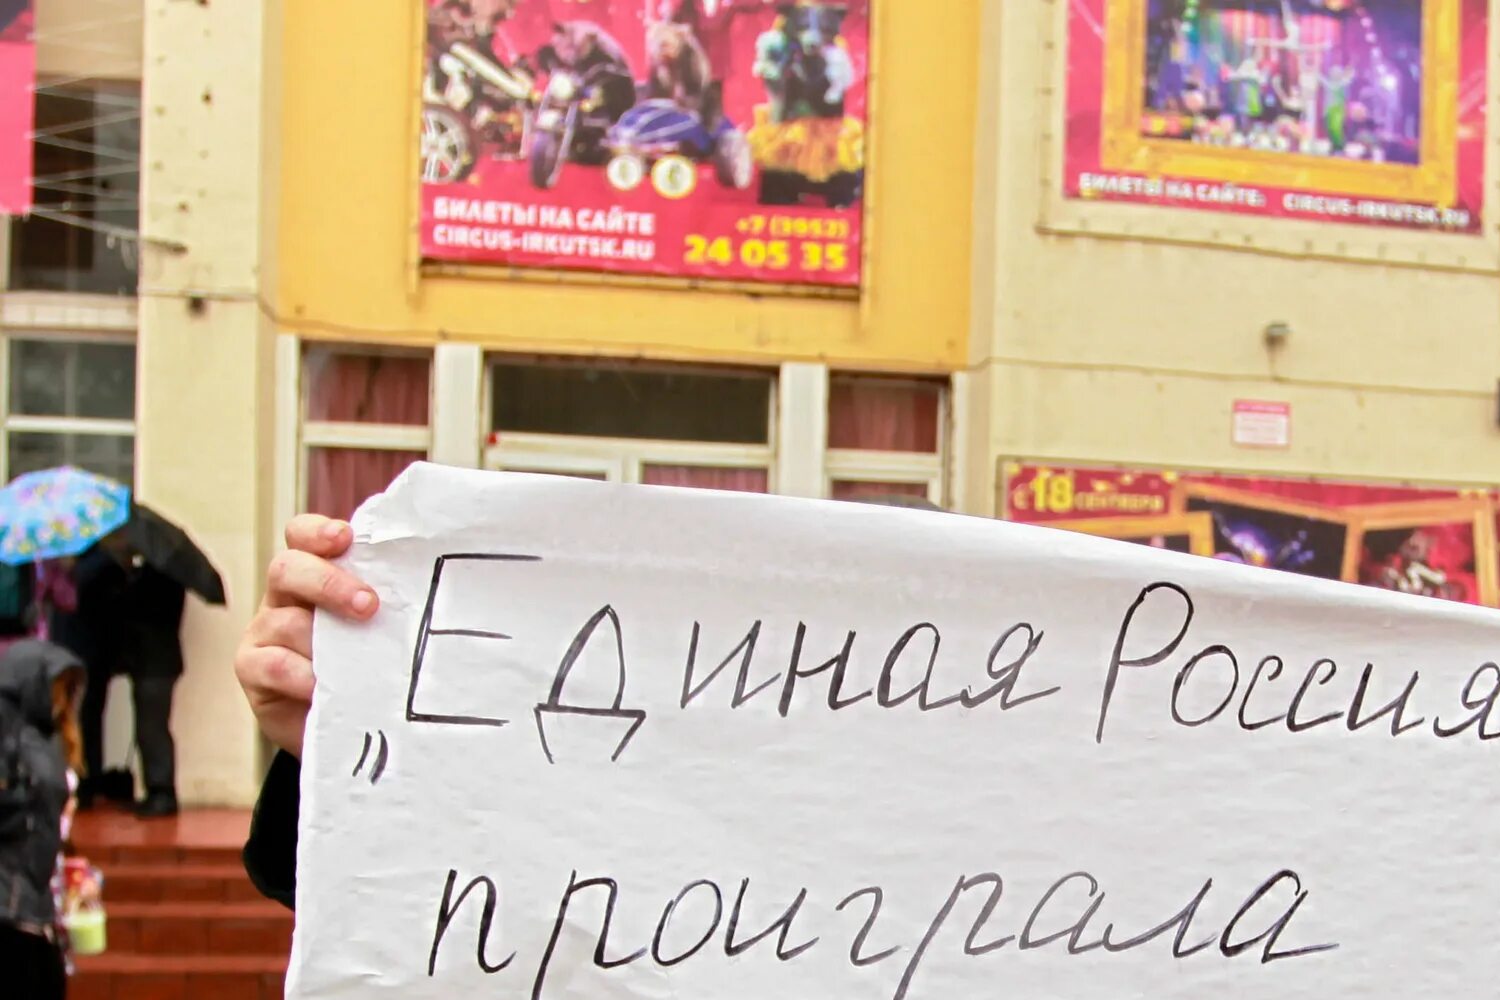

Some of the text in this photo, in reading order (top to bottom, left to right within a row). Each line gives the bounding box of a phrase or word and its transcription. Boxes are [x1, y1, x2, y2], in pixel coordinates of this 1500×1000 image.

[1079, 172, 1163, 197] БИЛЕТЫ
[1166, 180, 1193, 199] НА
[433, 197, 656, 235] БИЛЕТЫ НА САЙТЕ
[736, 214, 766, 235] +7
[433, 224, 656, 260] CIRCUS-IRKUTSK.RU
[684, 233, 848, 272] 24 05 35
[1030, 474, 1073, 513] 18
